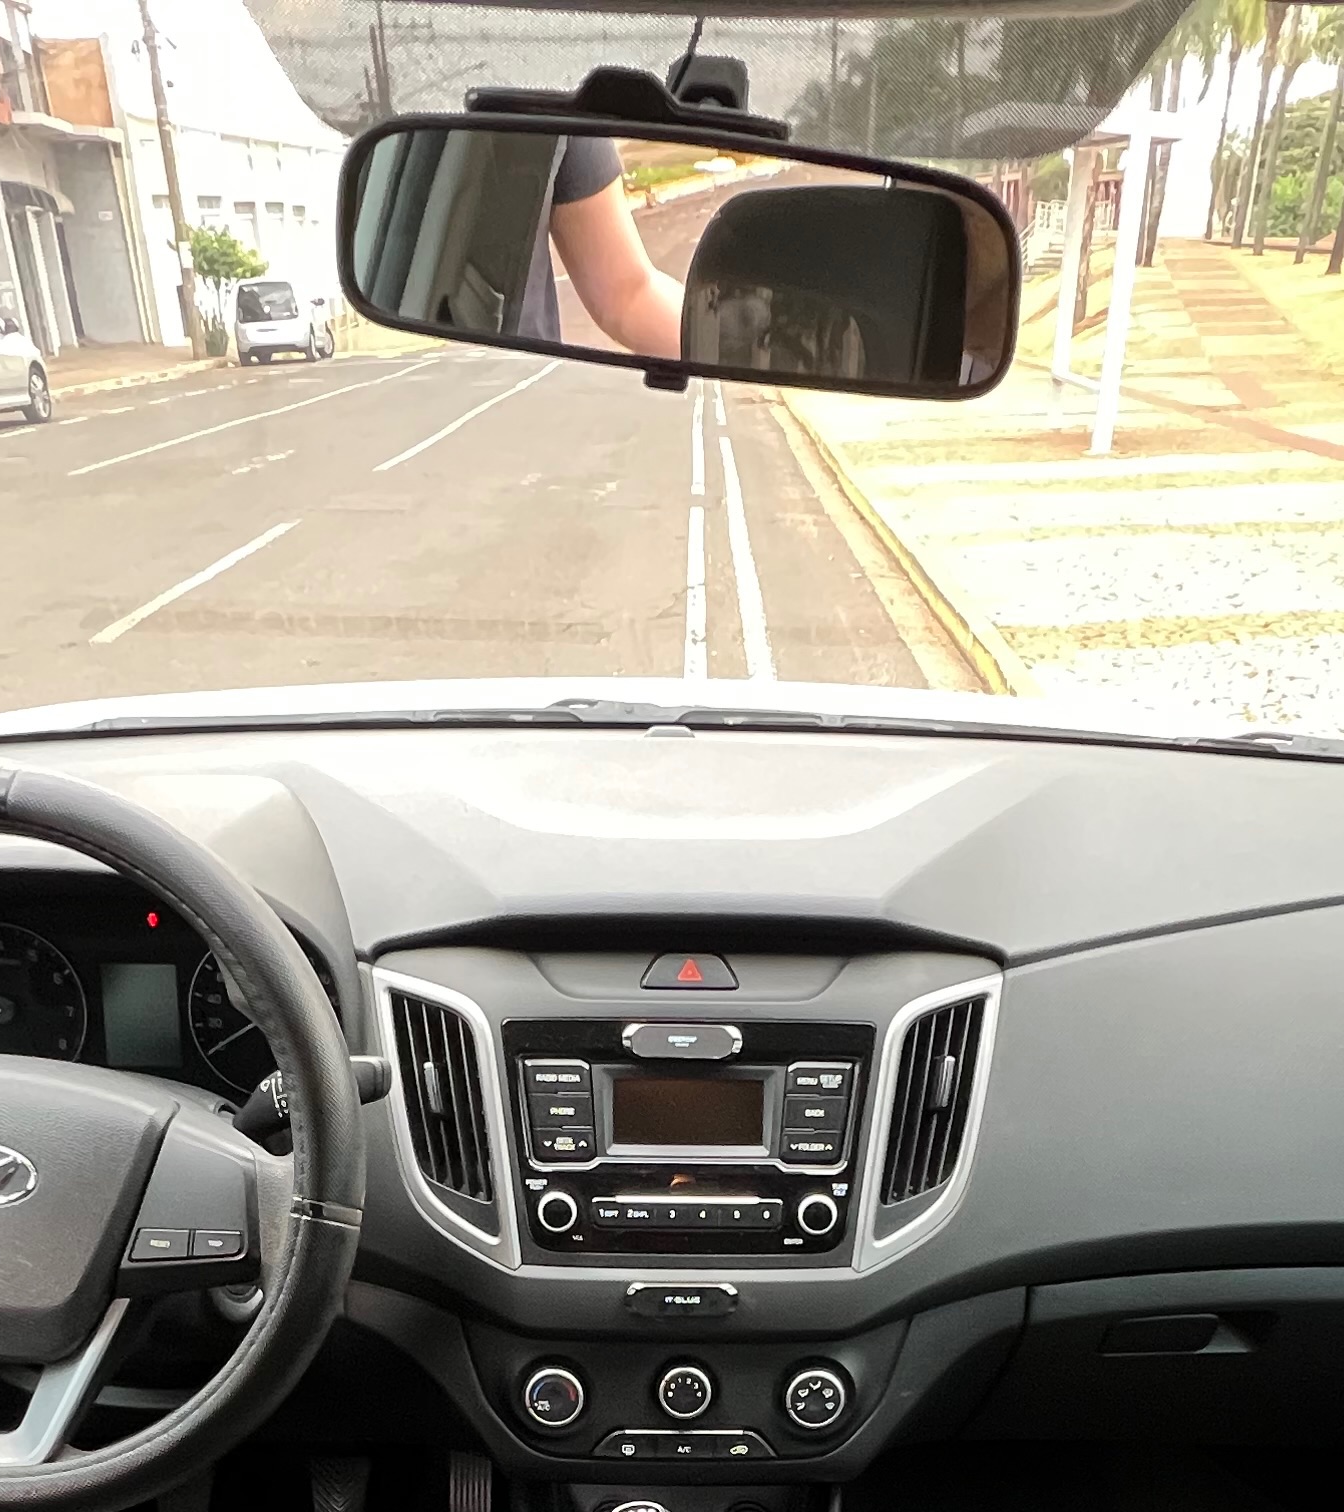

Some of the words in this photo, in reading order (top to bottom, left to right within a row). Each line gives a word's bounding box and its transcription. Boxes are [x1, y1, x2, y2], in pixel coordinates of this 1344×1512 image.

[558, 1073, 581, 1083] MEDIA
[798, 1142, 825, 1152] FOLDER
[669, 1209, 676, 1219] 3
[698, 1209, 706, 1219] 4
[686, 1377, 692, 1385] 2
[693, 1382, 699, 1390] 3
[676, 1445, 692, 1454] A/C
